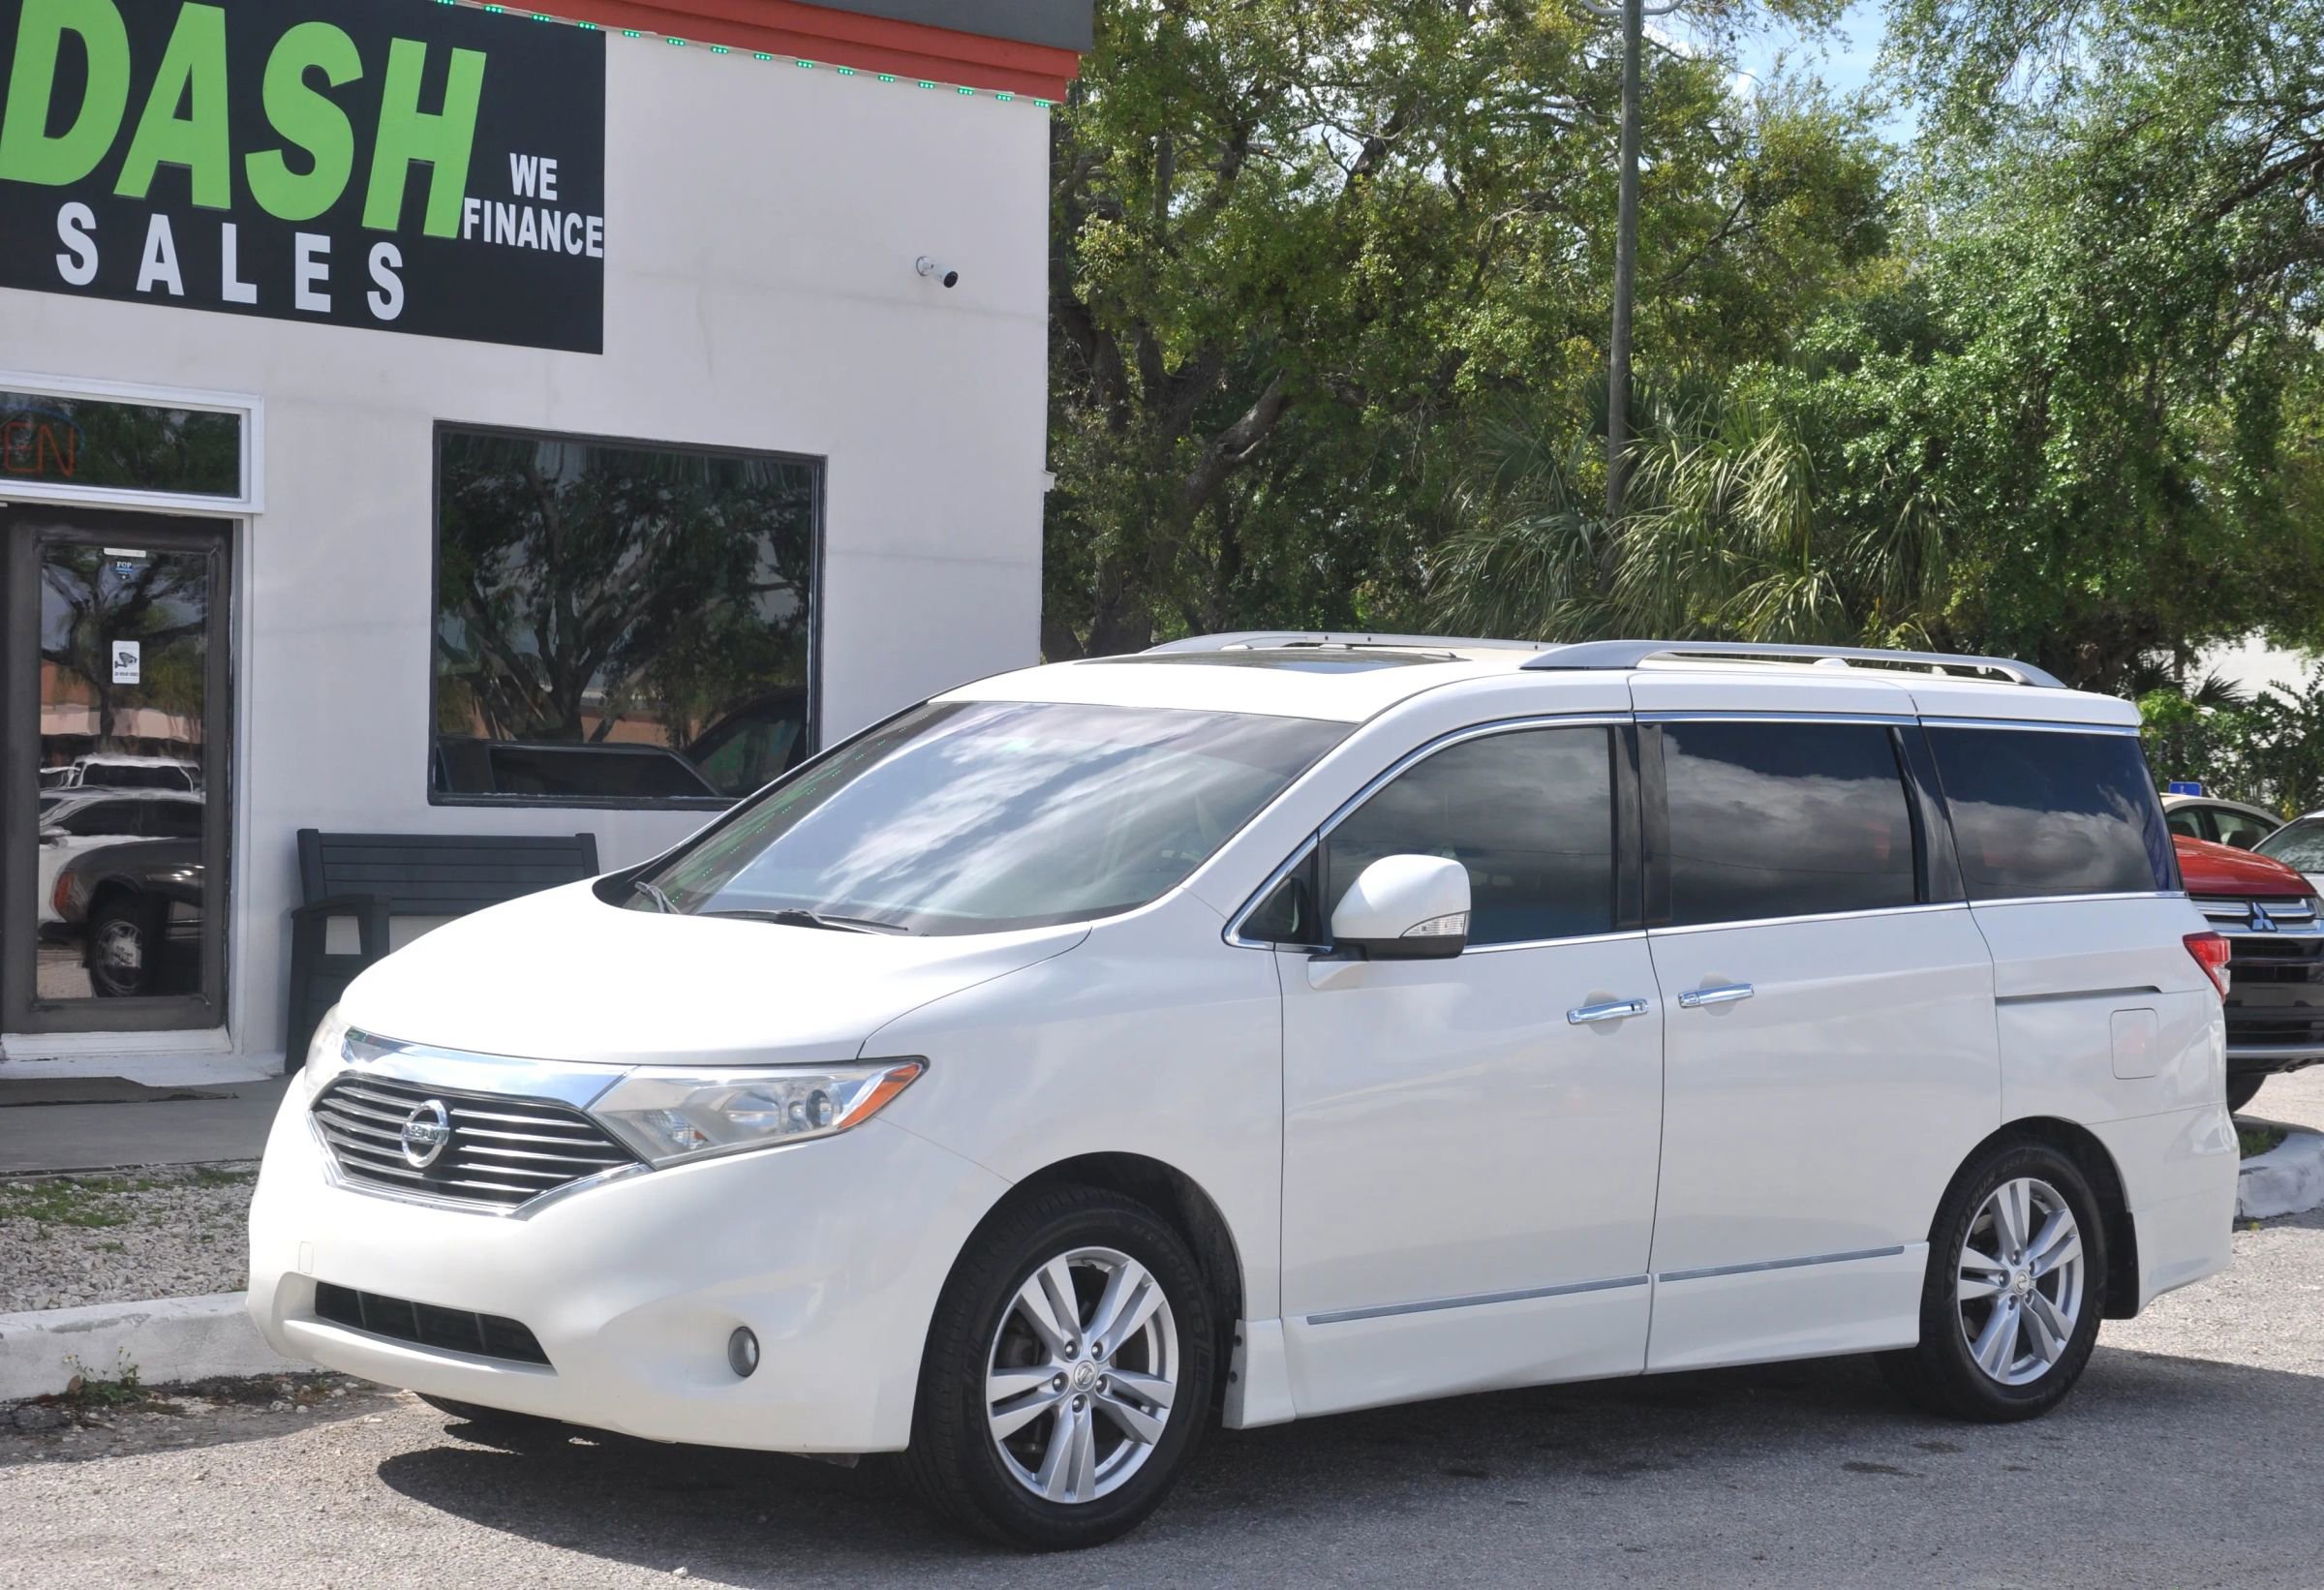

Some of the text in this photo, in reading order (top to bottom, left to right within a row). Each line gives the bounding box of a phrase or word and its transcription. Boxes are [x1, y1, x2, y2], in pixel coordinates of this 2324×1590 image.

[0, 0, 487, 239] DASH
[509, 152, 558, 201] WE
[55, 201, 405, 321] SALES
[464, 198, 604, 259] FINANCE
